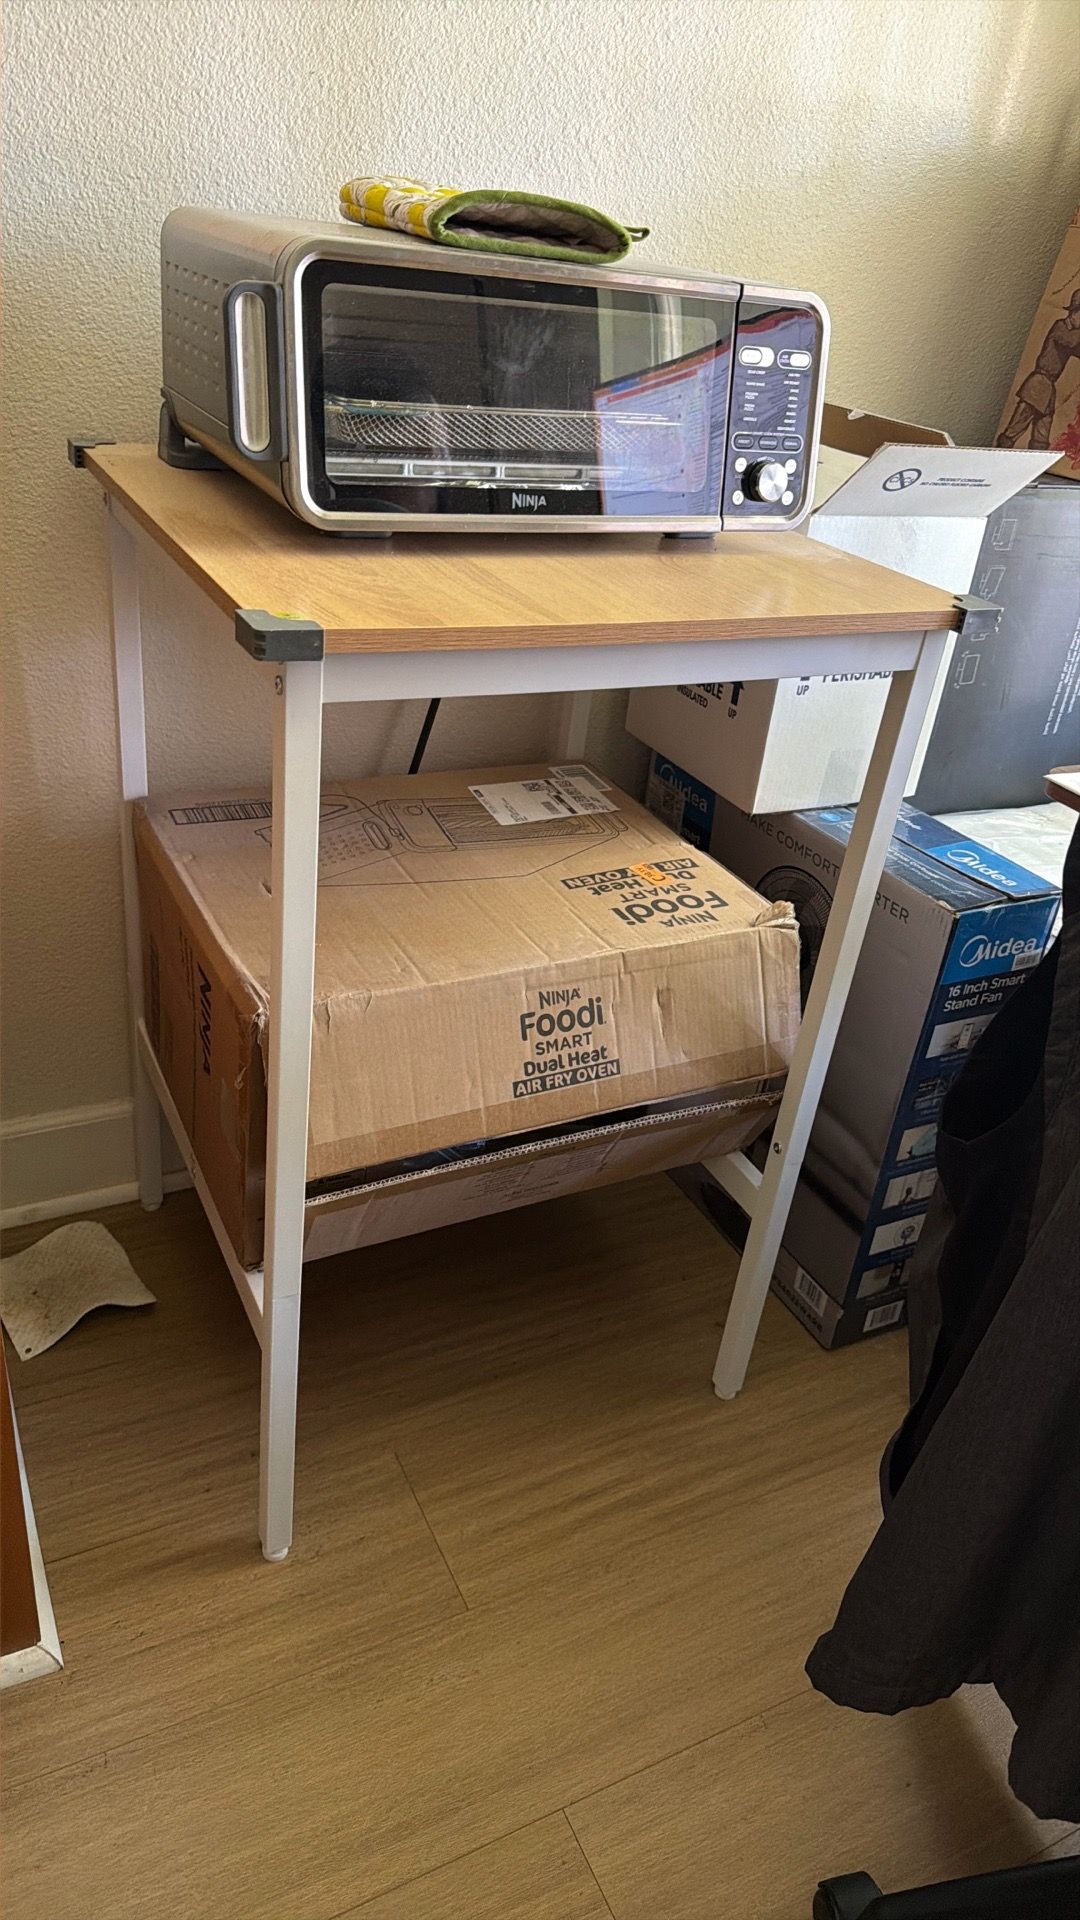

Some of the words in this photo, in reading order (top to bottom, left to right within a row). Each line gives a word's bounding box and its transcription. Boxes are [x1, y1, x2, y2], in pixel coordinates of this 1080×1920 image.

[512, 492, 547, 511] NINJA
[822, 671, 893, 683] PERISHAB
[796, 685, 810, 696] UP
[728, 707, 738, 719] UP
[776, 830, 840, 878] COMFORT
[662, 859, 693, 871] AIR
[947, 850, 1018, 886] Midea
[565, 872, 621, 888] OVEN
[587, 879, 644, 896] Heat
[619, 883, 692, 903] SMART
[611, 890, 729, 926] Foodi
[658, 910, 719, 928] NINJA
[959, 935, 1037, 967] Midea
[948, 985, 961, 998] 16
[962, 980, 988, 994] Inch
[989, 973, 1026, 989] Smart
[538, 988, 582, 1010] NINJA
[943, 995, 979, 1012] Stand
[980, 992, 1003, 1004] Fan
[520, 996, 605, 1041] Foodi
[535, 1031, 592, 1055] SMART
[523, 1054, 566, 1077] Dual
[567, 1045, 608, 1067] Heat
[515, 1079, 542, 1096] AIR
[545, 1070, 573, 1089] FRY
[576, 1061, 618, 1082] OVEN
